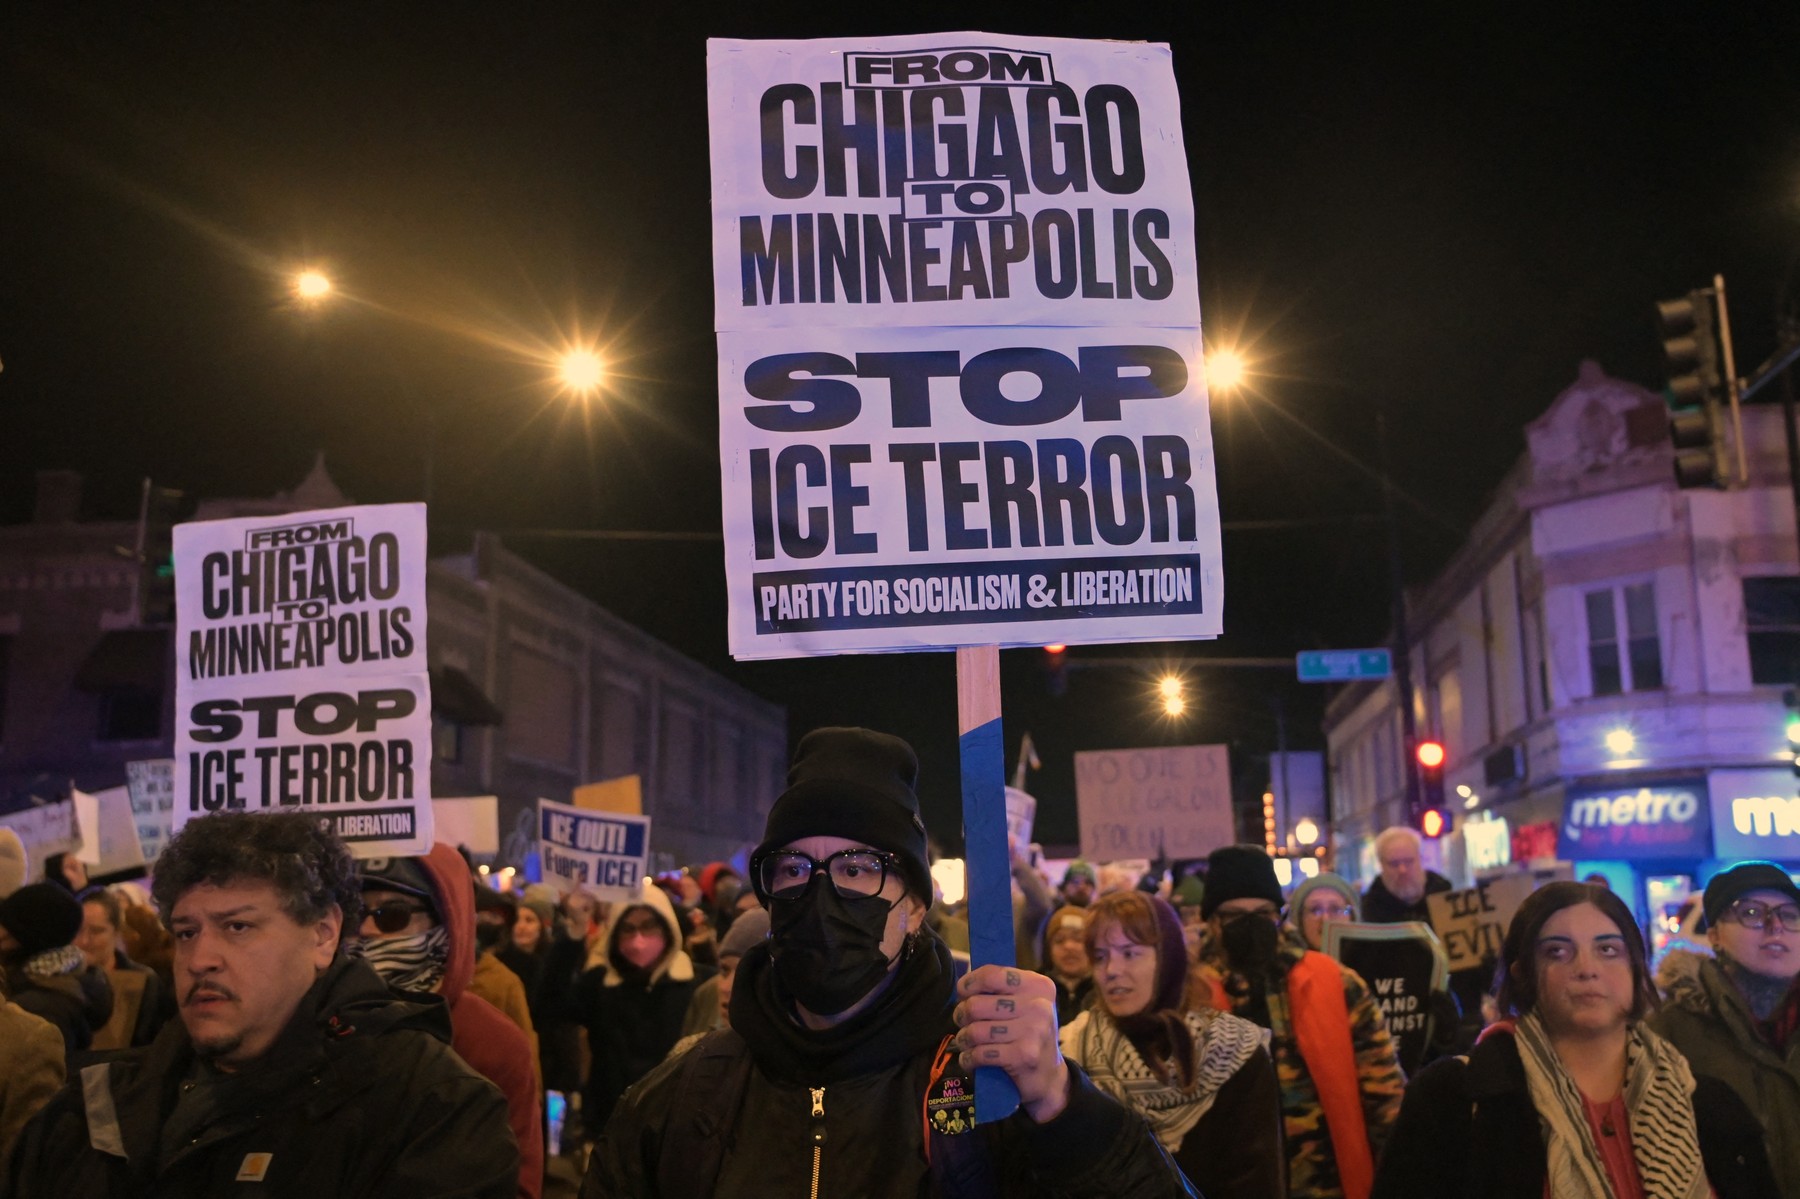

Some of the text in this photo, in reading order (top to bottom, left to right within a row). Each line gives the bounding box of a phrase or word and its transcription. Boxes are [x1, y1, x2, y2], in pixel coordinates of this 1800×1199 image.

[855, 52, 1045, 84] FROM
[911, 183, 1005, 215] TO
[740, 208, 1174, 307] MINNEAPOLIS
[744, 345, 1188, 432] STOP
[750, 434, 1197, 560] ICE TERROR
[251, 521, 348, 549] FROM
[277, 601, 325, 621] TO
[761, 567, 1193, 621] PARTY FOR SOCIALISM & LIBERATION
[190, 606, 414, 680] MINNEAPOLIS
[189, 688, 417, 743] STOP
[189, 748, 246, 811] ICE
[254, 739, 414, 807] TERROR
[337, 813, 411, 836] LIBERATION
[1570, 788, 1698, 827] metro
[550, 813, 575, 846] ICE
[577, 819, 627, 854] OUT!
[597, 858, 637, 887] ICE!
[1445, 882, 1497, 920] ICE
[1375, 978, 1405, 995] WE
[1380, 995, 1418, 1013] AND
[1385, 1013, 1426, 1032] INST
